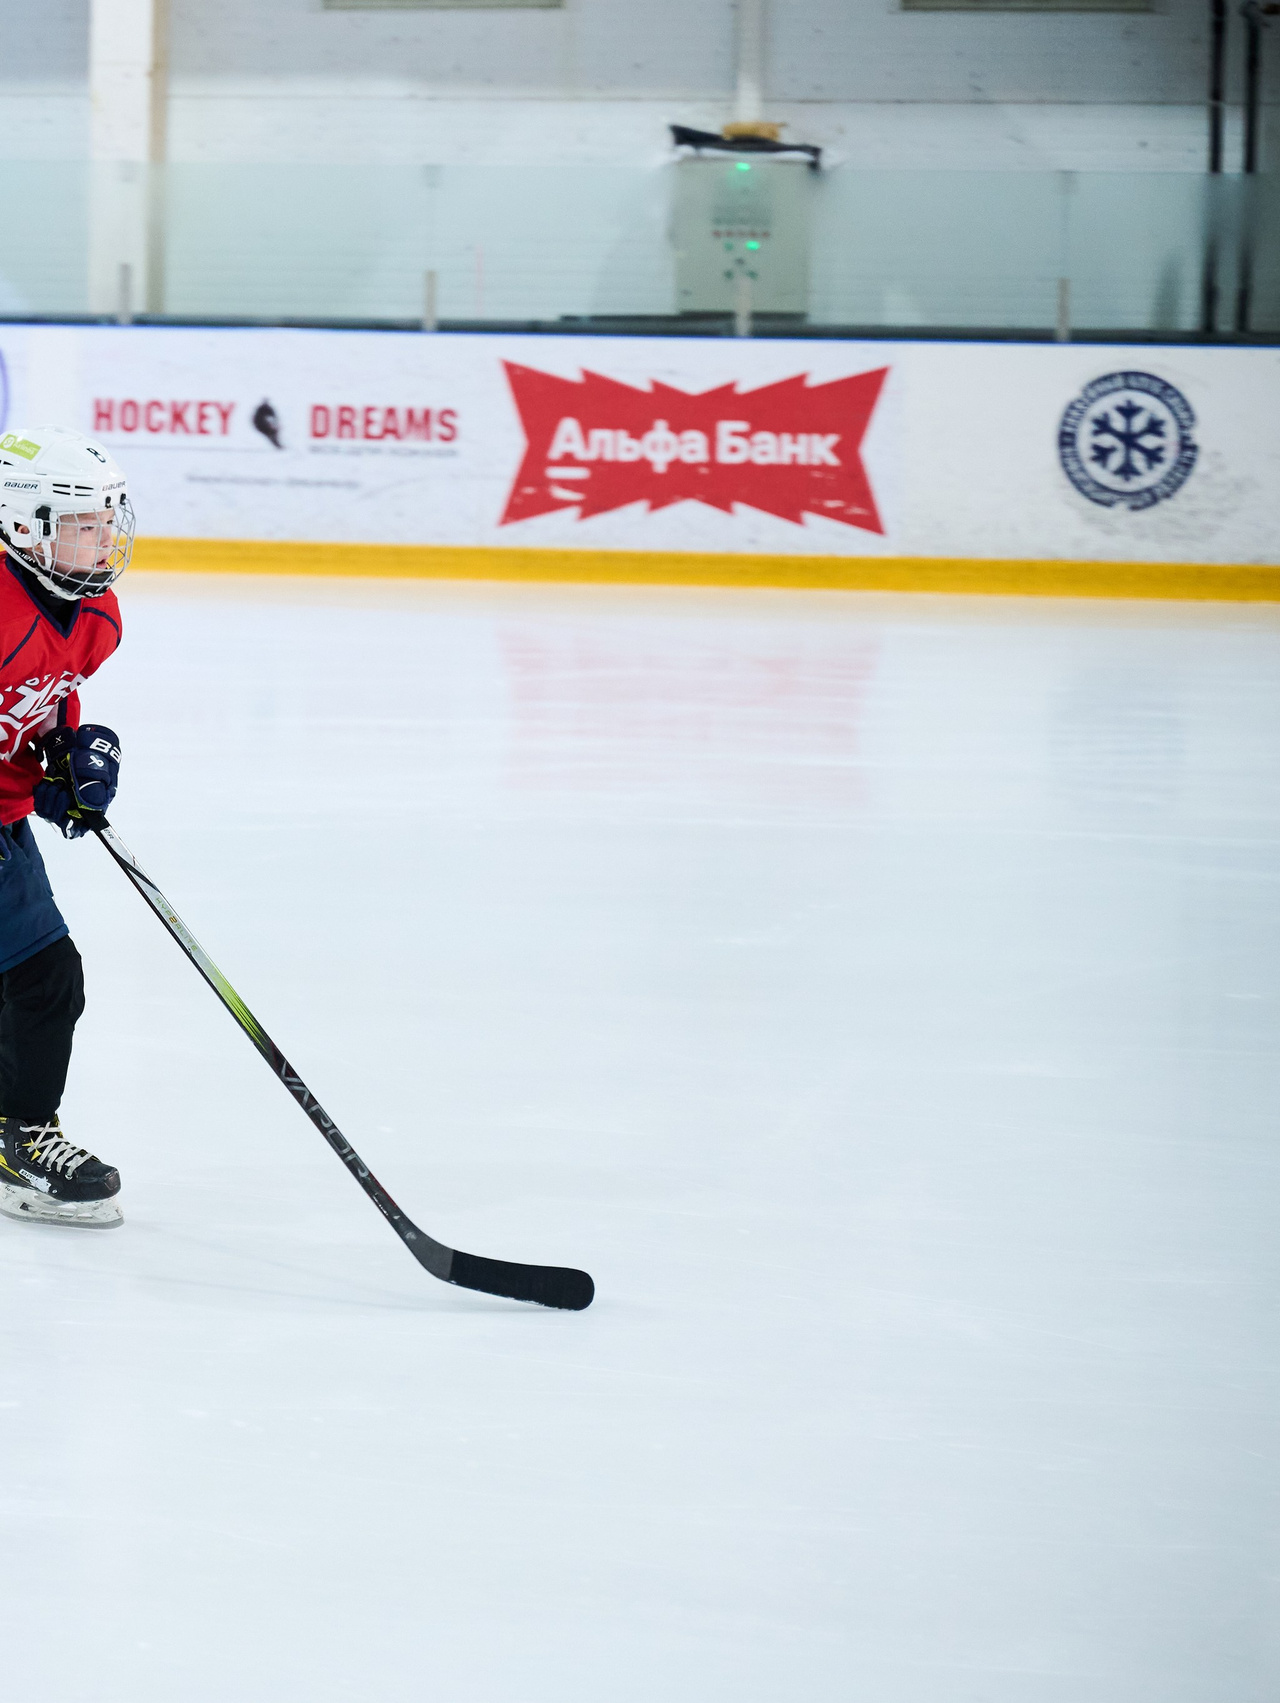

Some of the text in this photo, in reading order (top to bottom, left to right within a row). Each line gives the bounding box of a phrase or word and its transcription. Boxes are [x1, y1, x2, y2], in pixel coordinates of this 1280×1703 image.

[93, 398, 459, 442] HOCKEY DREAMS
[547, 416, 842, 474] Альфа Банк
[3, 480, 39, 490] BAUER
[102, 480, 127, 492] BAUER
[280, 1059, 370, 1178] VAPOR
